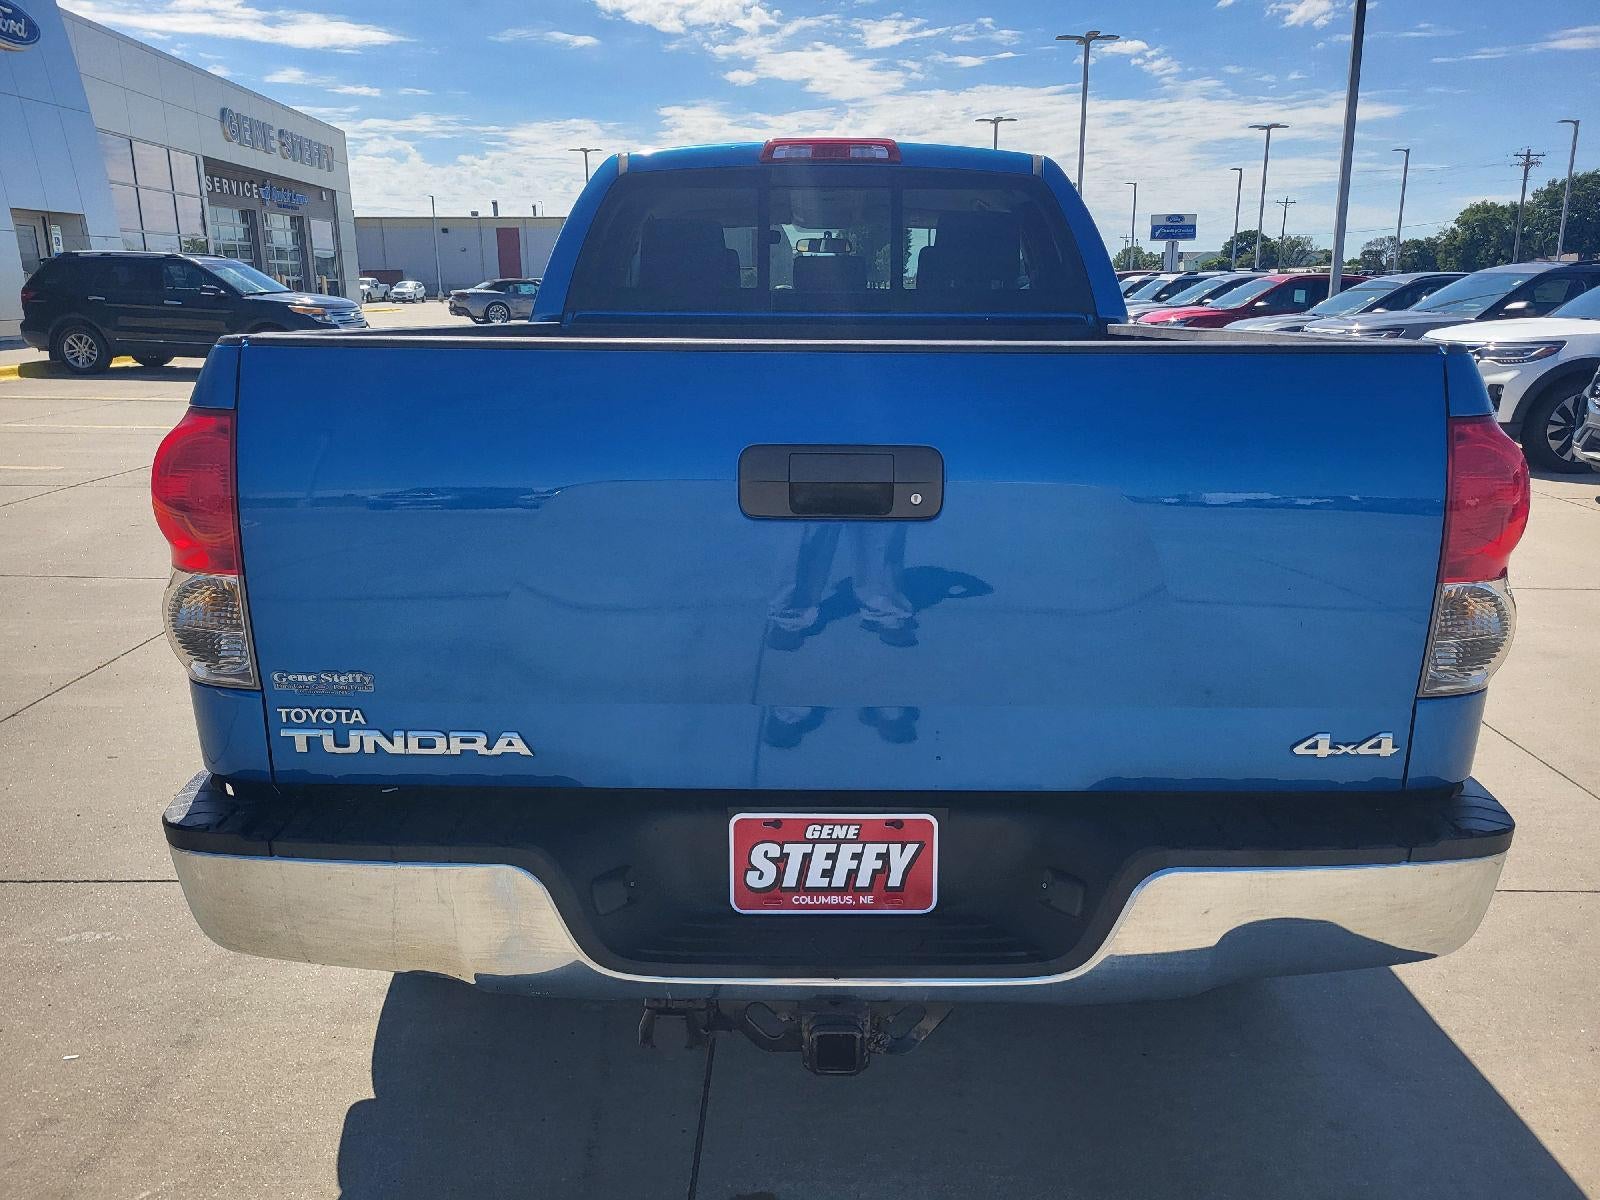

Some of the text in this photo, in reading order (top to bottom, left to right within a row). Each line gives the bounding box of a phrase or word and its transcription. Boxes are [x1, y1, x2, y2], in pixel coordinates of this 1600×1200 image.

[0, 5, 28, 38] ord
[220, 107, 334, 172] GENE STEFFY
[205, 175, 259, 199] SERVICE
[273, 672, 371, 685] Gene Steffy
[277, 708, 366, 724] TOYOTA
[280, 729, 534, 756] TUNDRA
[1292, 732, 1400, 757] 4x4
[804, 824, 860, 839] GENE
[745, 842, 922, 890] STEFFY
[792, 895, 874, 906] COLUMBUS, NE
